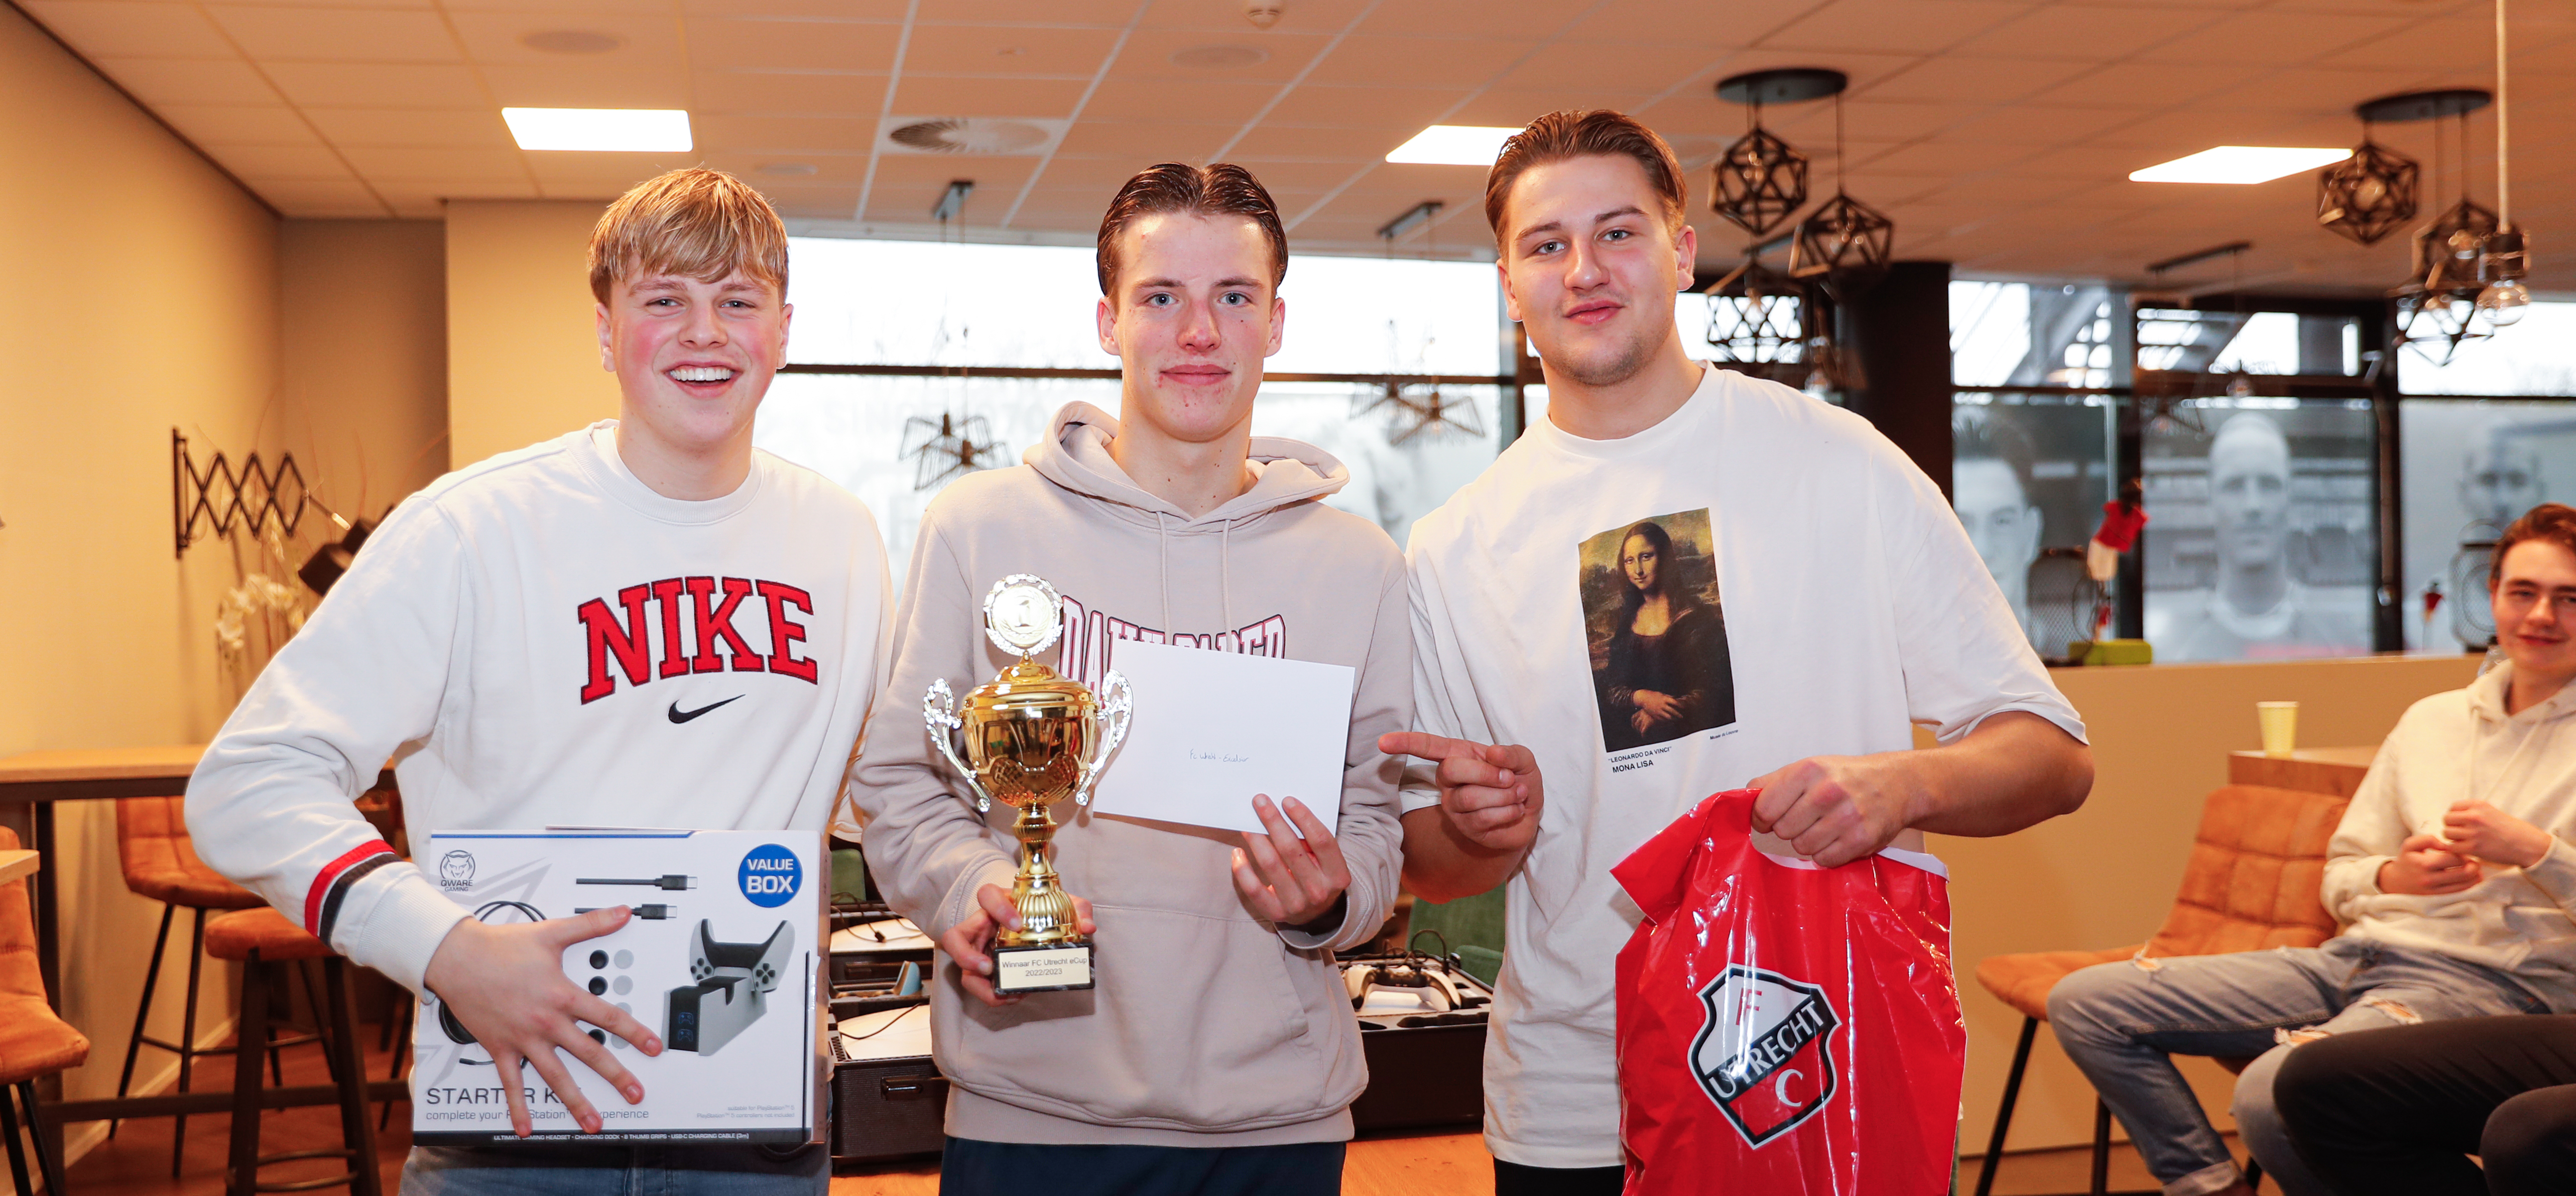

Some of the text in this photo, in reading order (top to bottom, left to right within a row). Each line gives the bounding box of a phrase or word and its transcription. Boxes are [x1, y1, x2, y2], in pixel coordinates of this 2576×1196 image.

[578, 576, 818, 705] NIKE
[1612, 760, 1654, 773] MONA LISA
[747, 859, 794, 870] VALUE
[747, 875, 794, 893] BOX
[1025, 968, 1063, 977] 2022/2023
[1736, 988, 1762, 1025] F
[1708, 1000, 1824, 1098] UTRECHT
[427, 1088, 535, 1104] STARTR
[1775, 1069, 1803, 1107] C
[426, 1110, 476, 1121] complete
[479, 1112, 503, 1122] your
